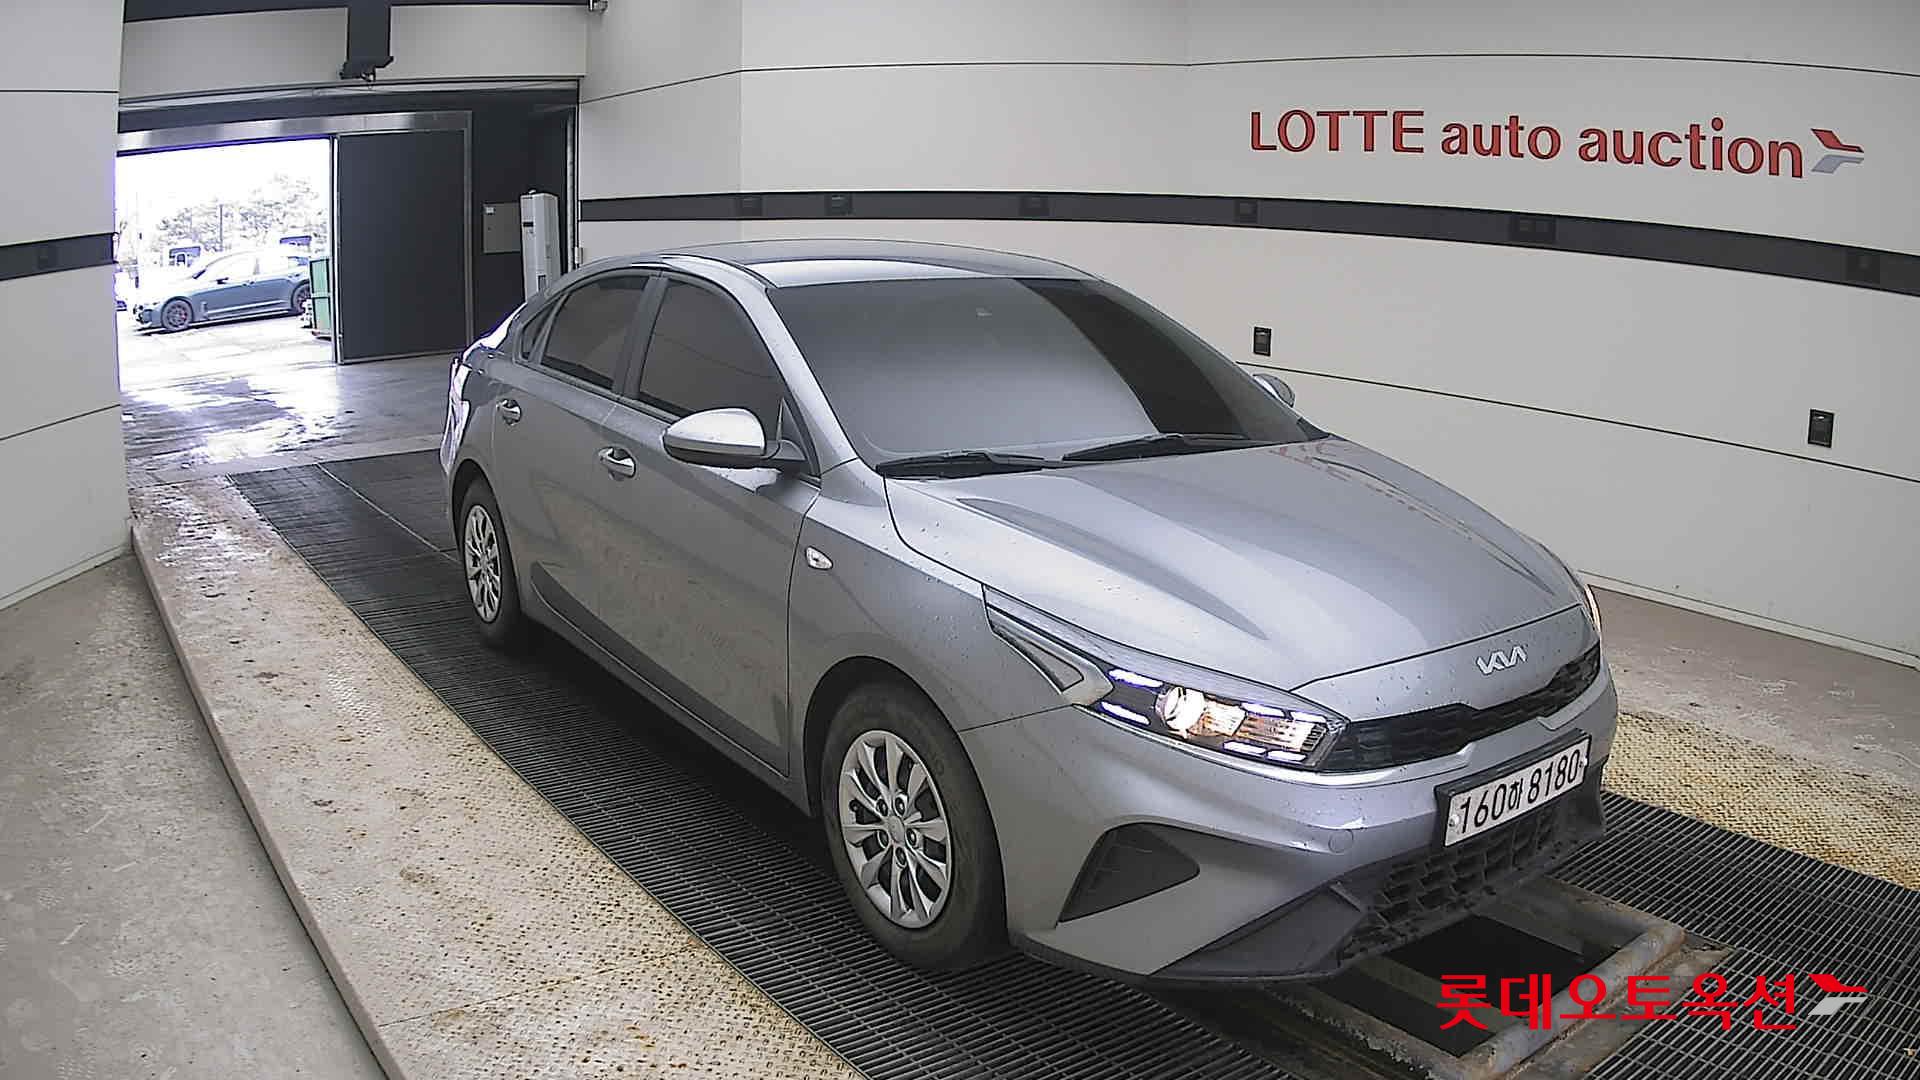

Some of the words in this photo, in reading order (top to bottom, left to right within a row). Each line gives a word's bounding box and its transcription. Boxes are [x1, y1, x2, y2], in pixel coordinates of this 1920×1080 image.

[1250, 109, 1425, 153] LOTTE
[1440, 114, 1562, 160] auto
[1577, 116, 1804, 178] auction
